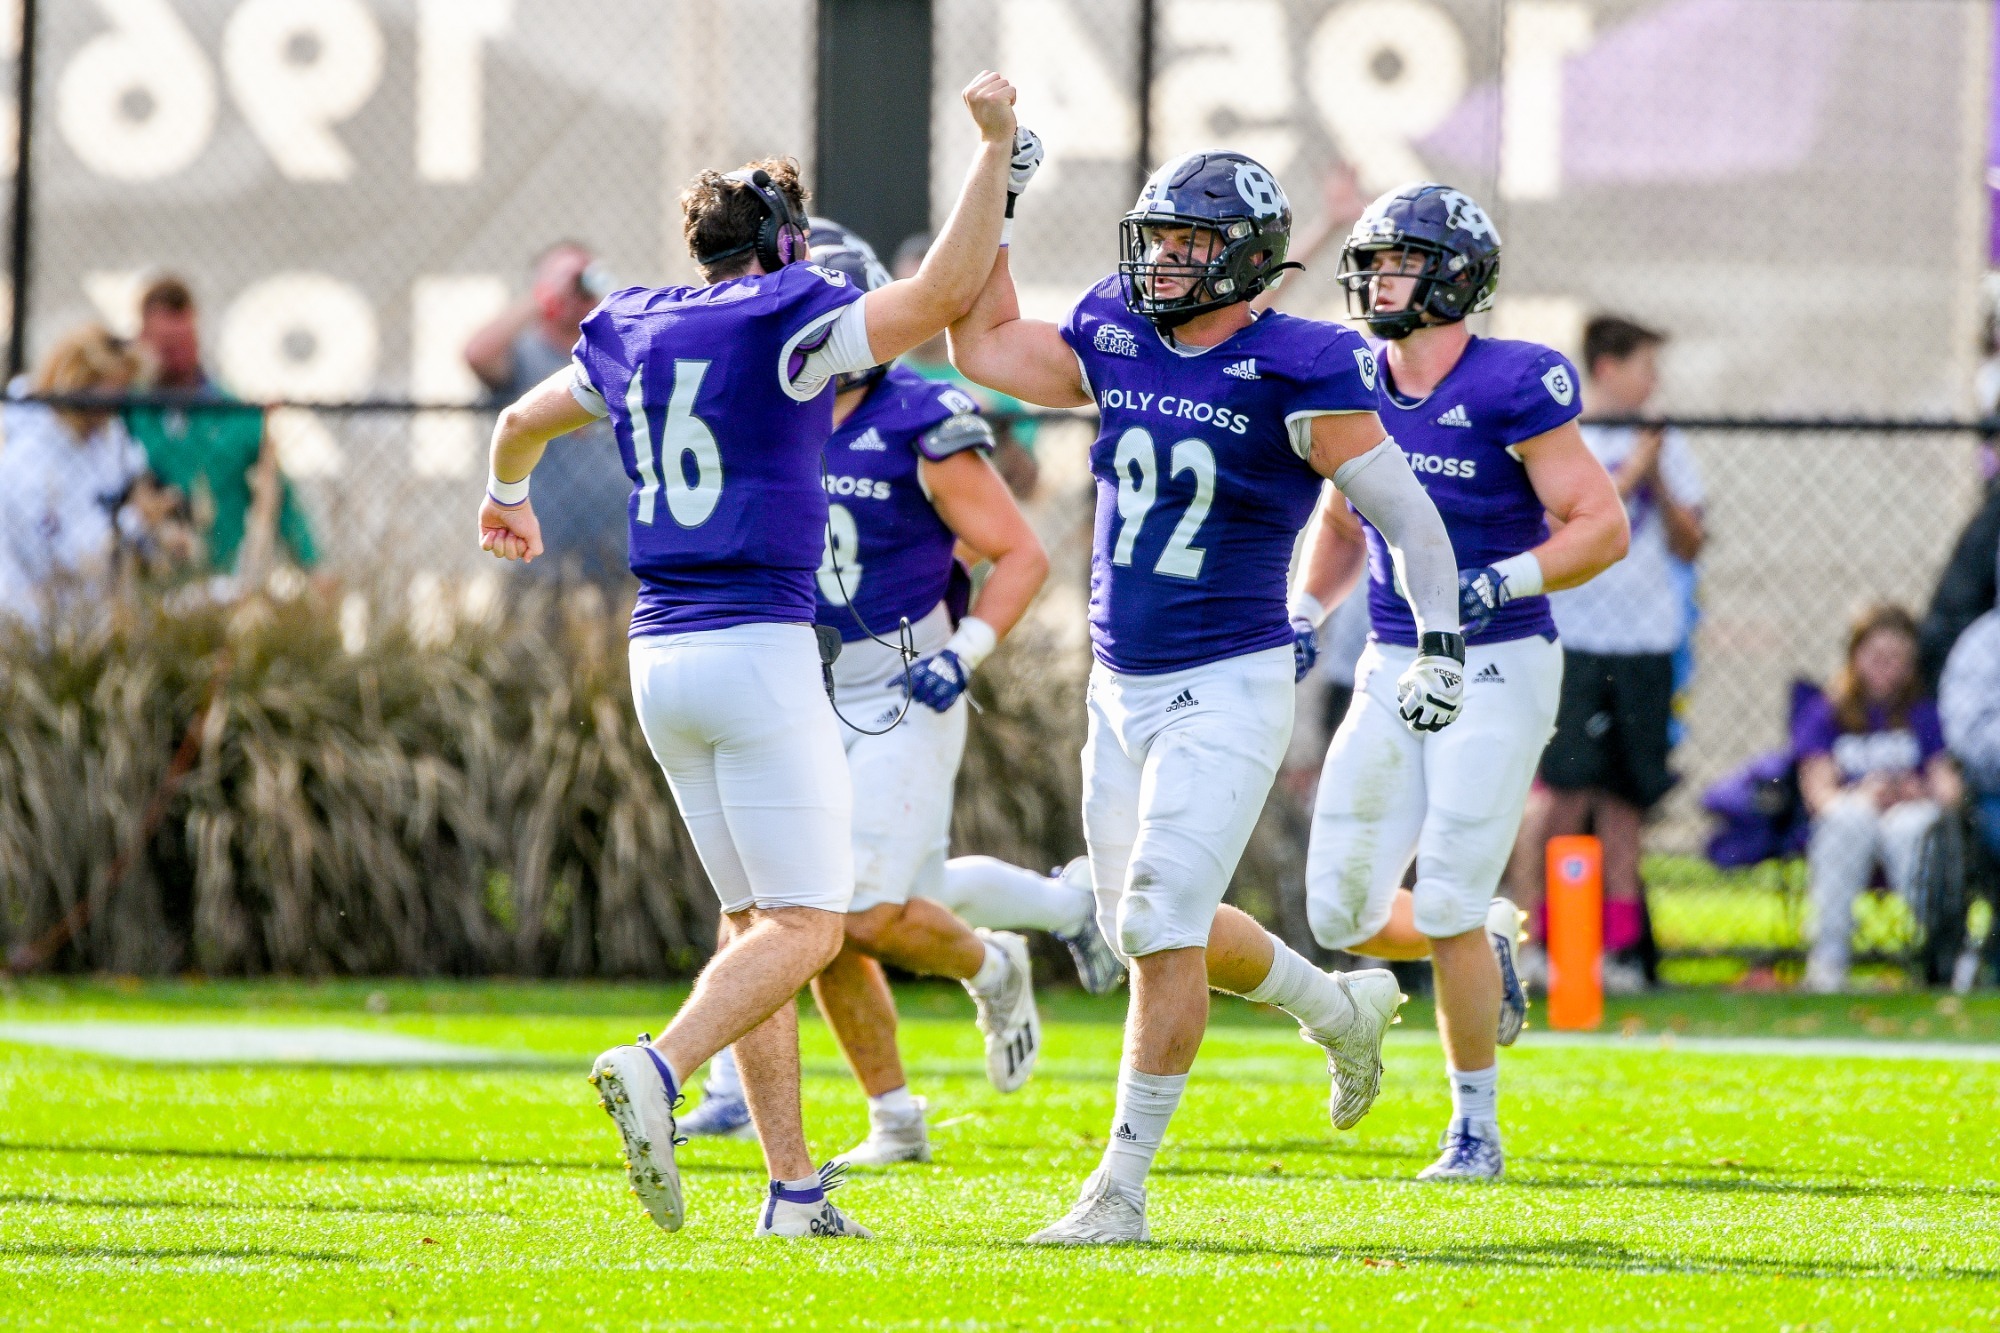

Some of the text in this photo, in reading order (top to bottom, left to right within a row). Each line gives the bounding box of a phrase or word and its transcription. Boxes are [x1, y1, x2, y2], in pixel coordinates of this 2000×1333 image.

[1093, 335, 1139, 351] PATRIOT
[1094, 342, 1138, 358] LEAGUE
[1222, 366, 1262, 380] adidas
[1101, 389, 1250, 436] HOLY CROSS
[625, 358, 725, 530] 16
[1403, 451, 1476, 479] ROSS
[1112, 425, 1217, 581] 92
[815, 503, 864, 608] 8
[1165, 699, 1200, 713] adidas
